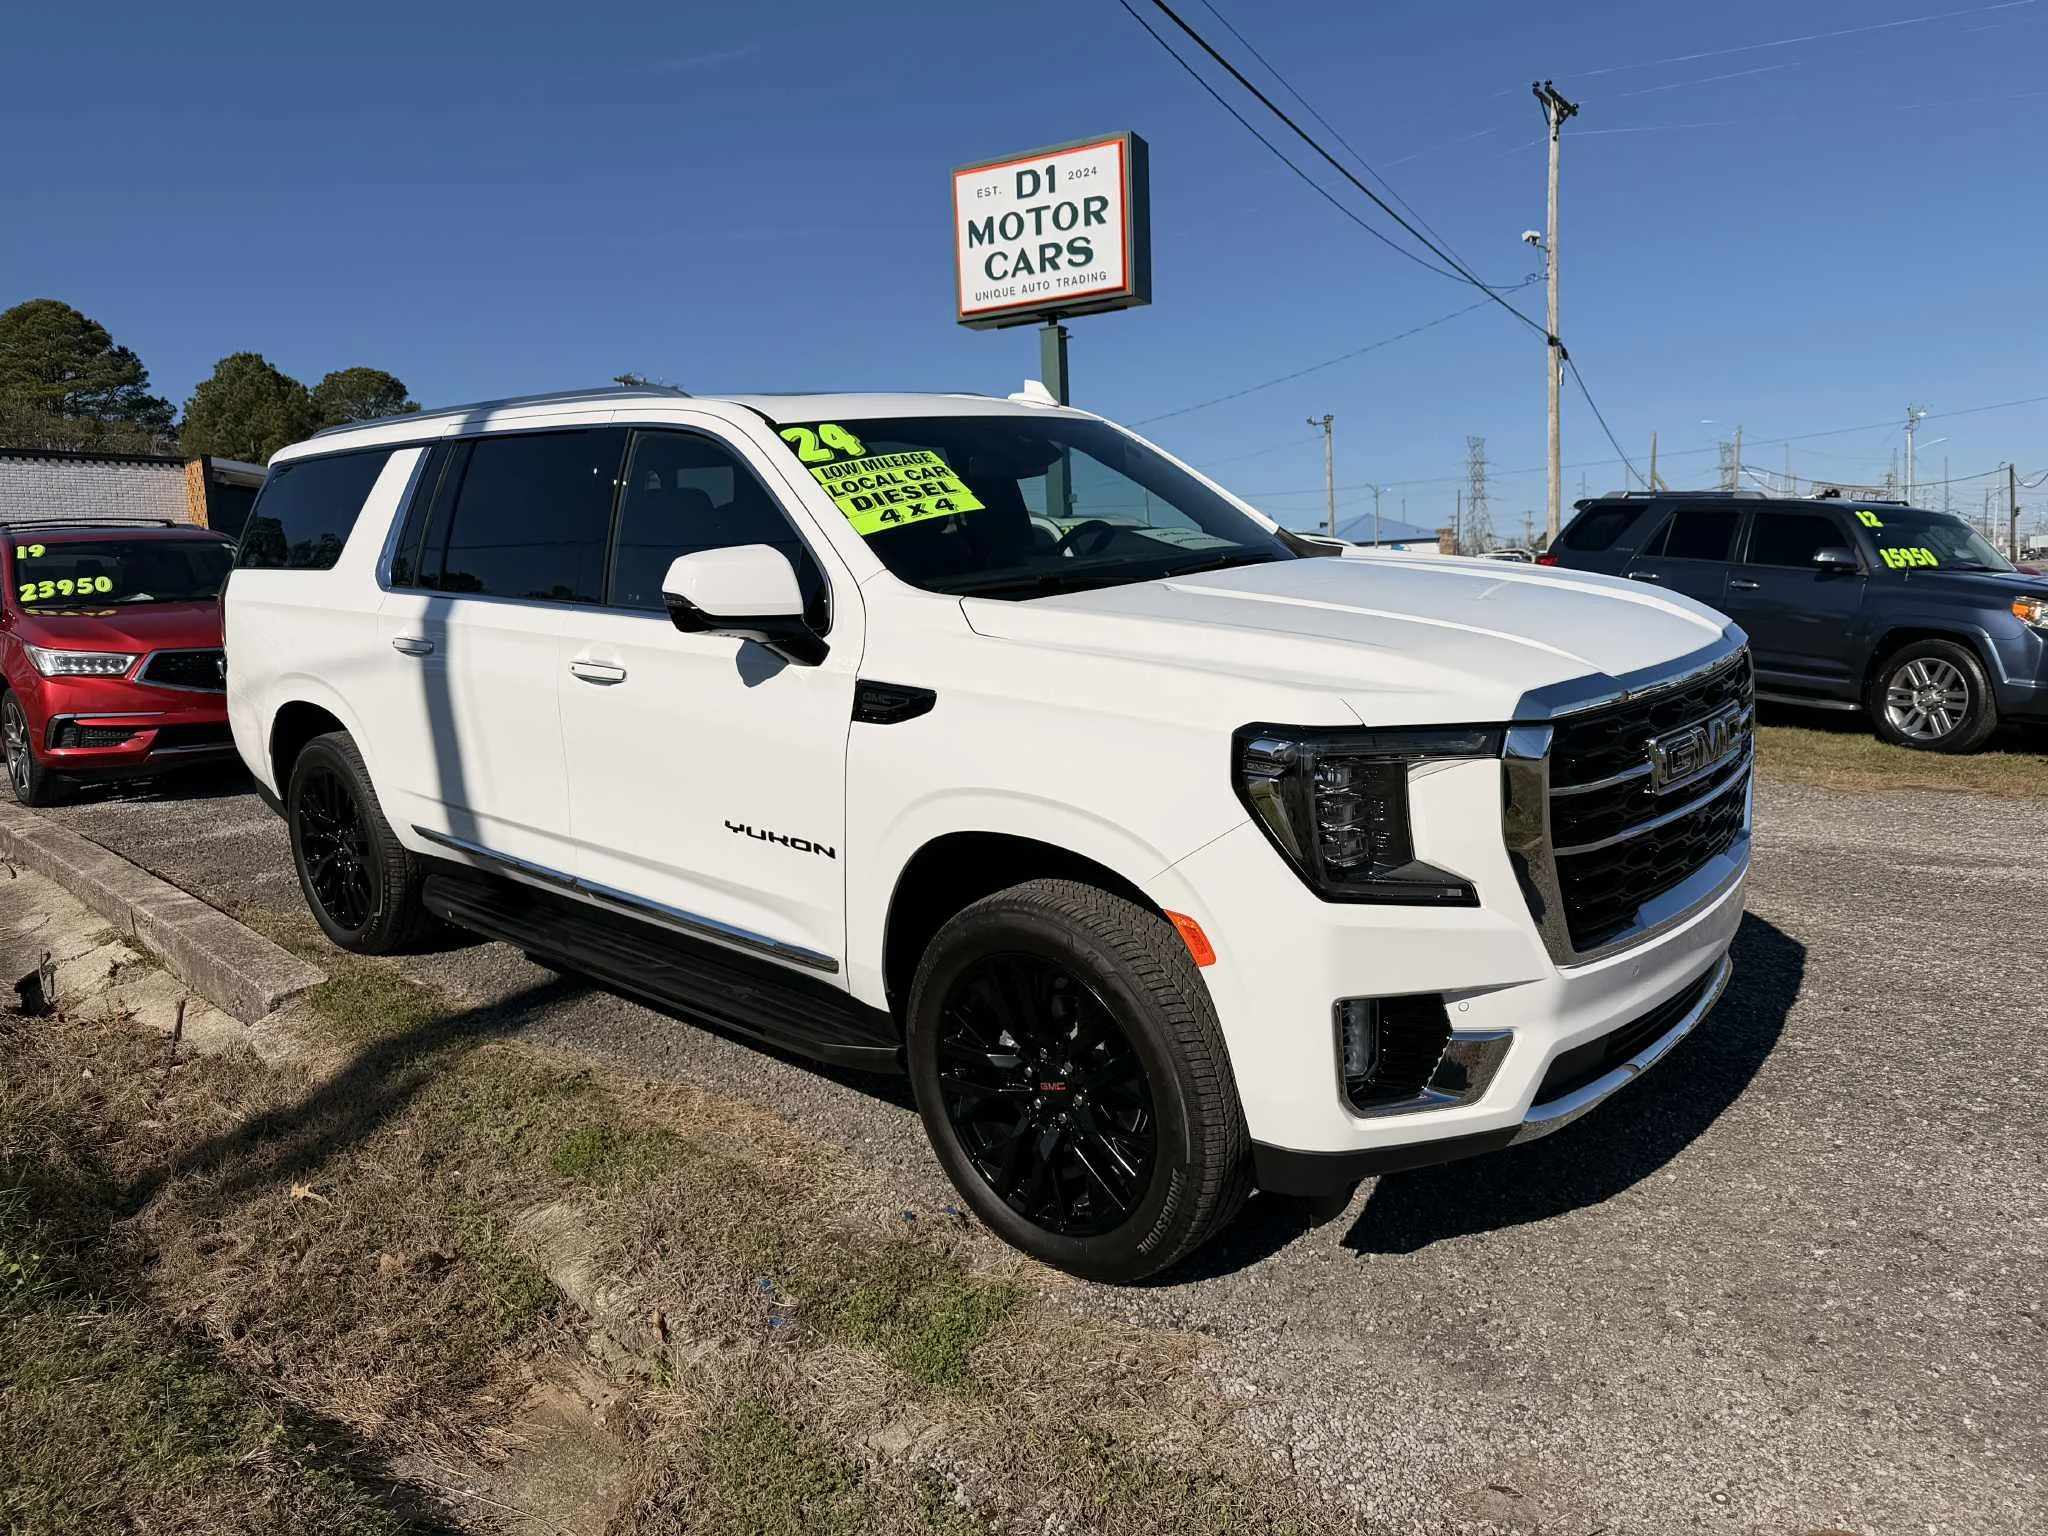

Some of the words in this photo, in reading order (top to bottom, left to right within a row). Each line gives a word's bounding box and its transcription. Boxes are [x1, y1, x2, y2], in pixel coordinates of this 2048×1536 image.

[976, 185, 1002, 199] EST.
[1016, 165, 1056, 200] D1
[1068, 166, 1097, 181] 2024
[968, 195, 1109, 249] MOTOR
[984, 236, 1094, 281] CARS
[975, 286, 1016, 302] UNIQUE
[1021, 280, 1050, 294] AUTO
[1056, 271, 1107, 288] TRADING
[780, 423, 866, 462] 24
[820, 462, 860, 480] LOW
[864, 452, 931, 472] MILEAGE
[828, 472, 904, 498] LOCAL
[904, 465, 950, 483] CAR
[850, 481, 958, 512] DIESEL
[1855, 510, 1884, 528] 12
[16, 544, 46, 559] 19
[1879, 547, 1939, 569] 15950
[19, 576, 113, 602] 23950
[1657, 708, 1742, 785] GMC
[725, 820, 836, 859] YUKON
[1039, 1081, 1067, 1092] GMC
